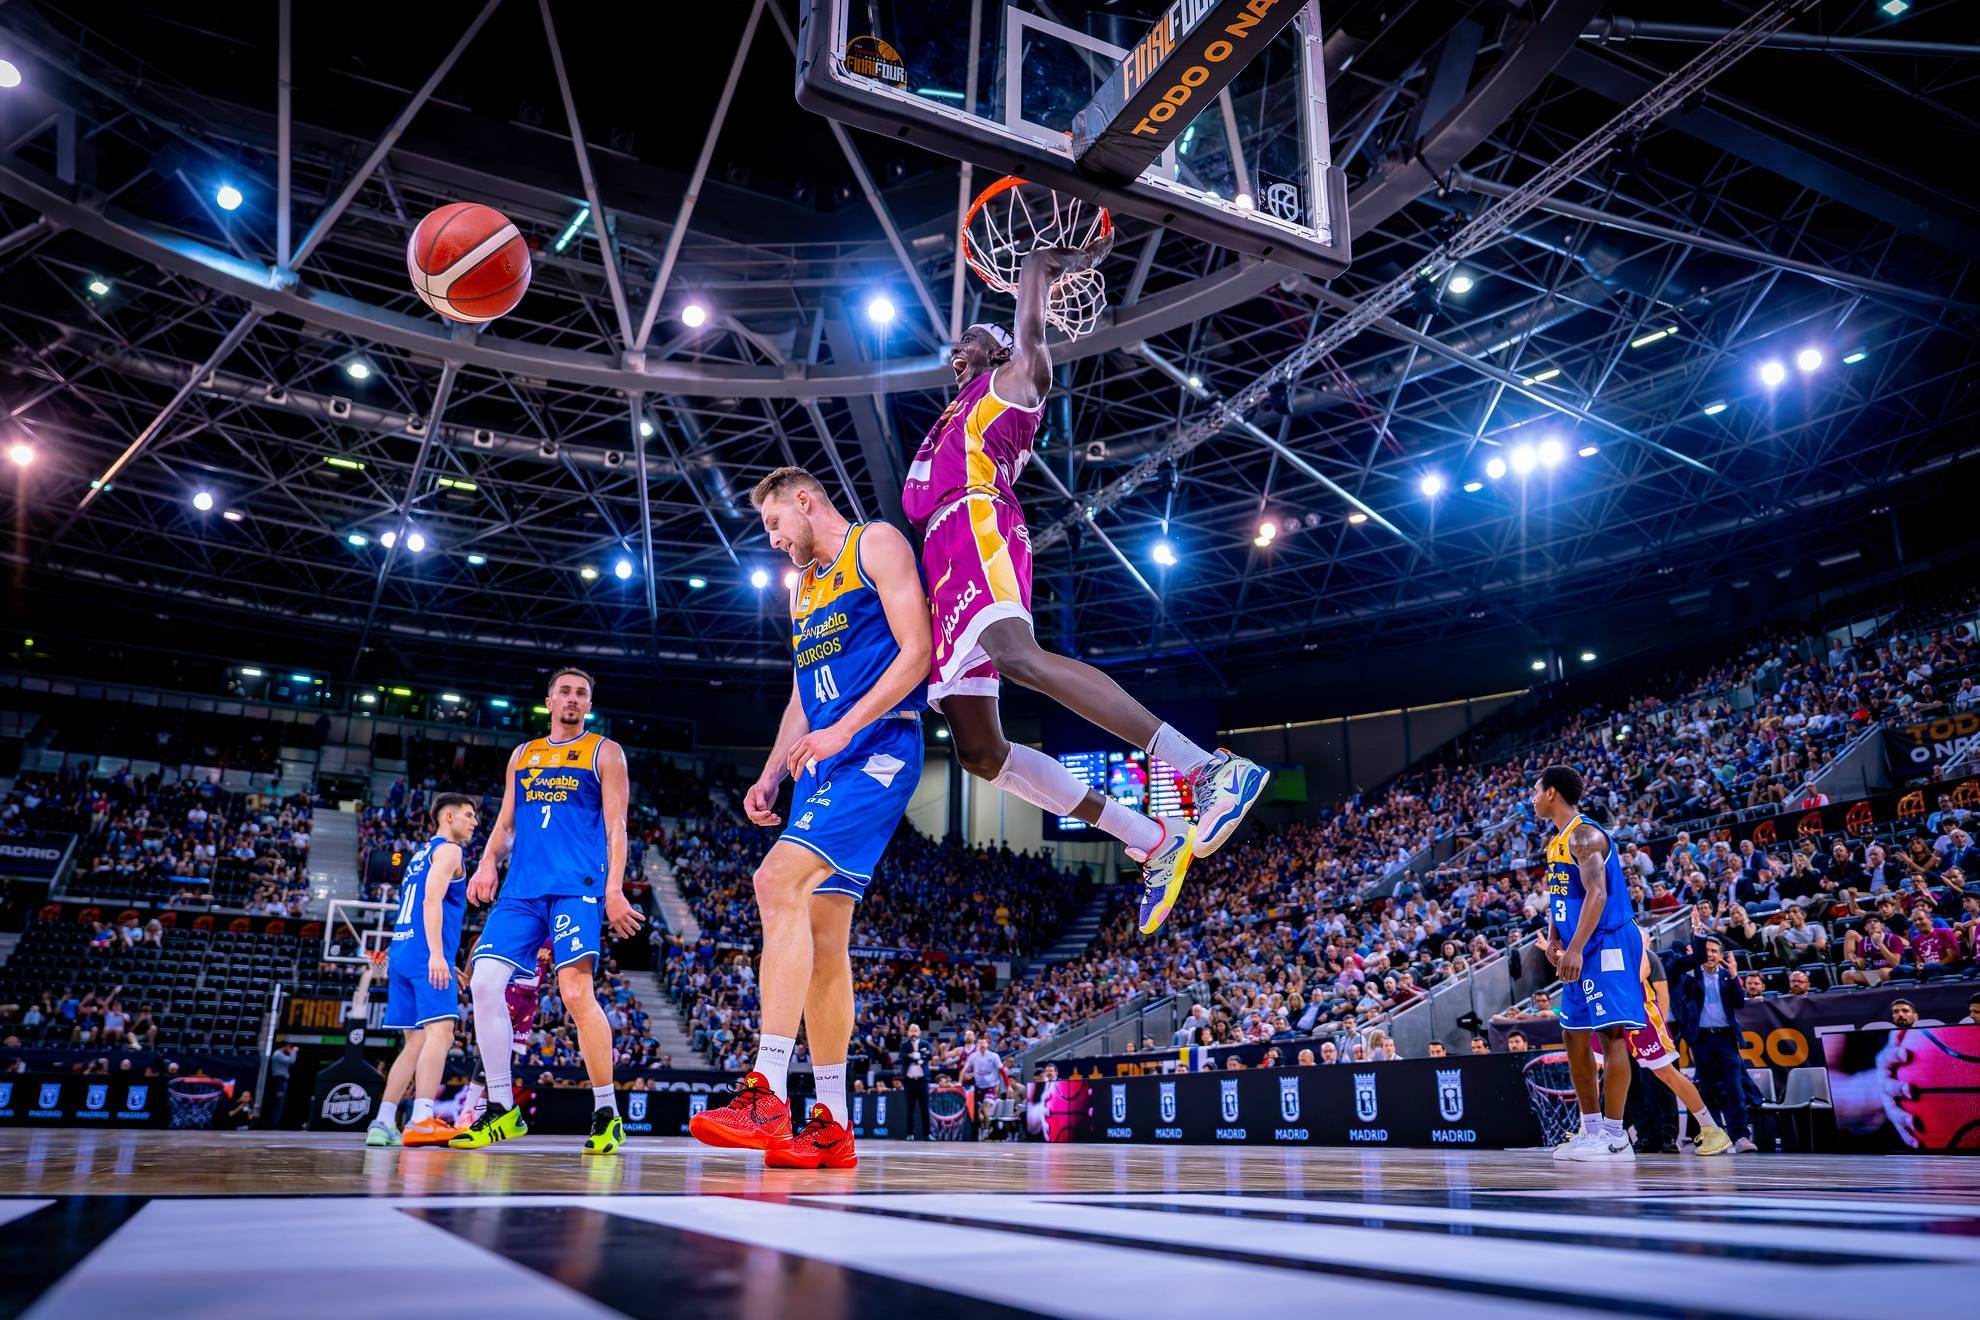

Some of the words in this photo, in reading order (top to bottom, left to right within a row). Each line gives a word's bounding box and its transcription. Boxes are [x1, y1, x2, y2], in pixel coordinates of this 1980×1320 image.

[1123, 0, 1215, 101] FINALFOU
[1131, 66, 1210, 135] TODO
[1204, 40, 1233, 62] O
[796, 637, 842, 669] BURGOS
[814, 665, 840, 704] 40
[1910, 746, 1930, 763] O
[526, 790, 567, 802] BURGOS
[541, 805, 551, 829] 7
[396, 882, 417, 925] 11
[1555, 899, 1567, 922] 3
[1155, 1127, 1183, 1139] MADRID
[1216, 1128, 1246, 1140] MADRID
[1275, 1128, 1309, 1141] MADRID
[1350, 1129, 1388, 1142] MADRID
[1432, 1129, 1477, 1143] MADRID
